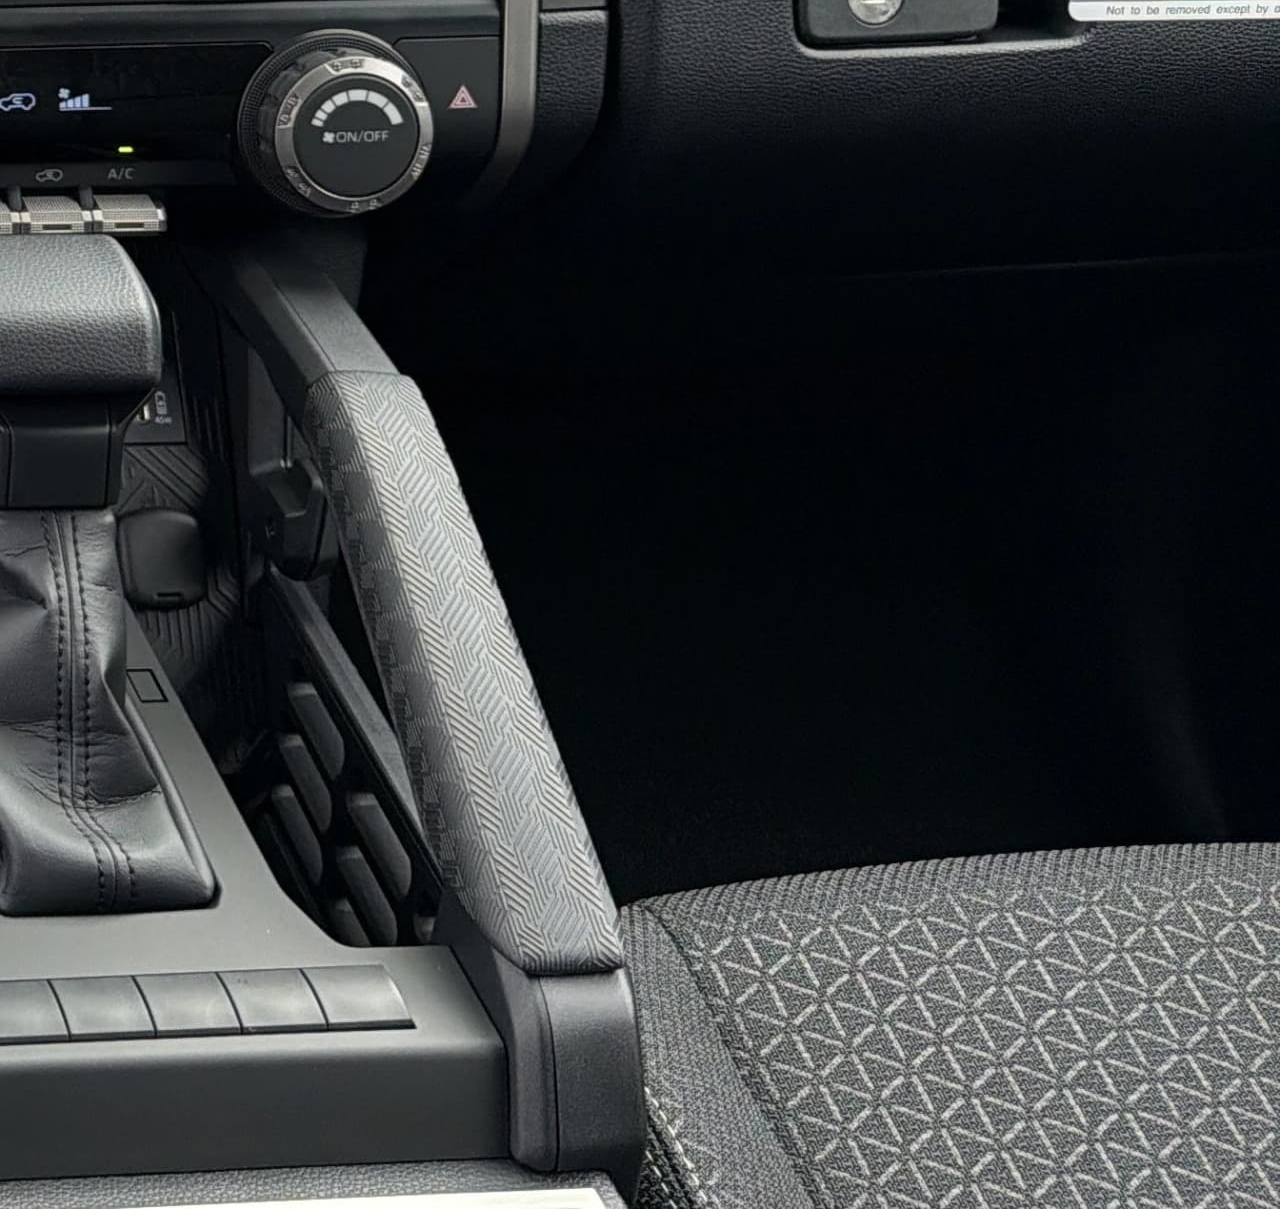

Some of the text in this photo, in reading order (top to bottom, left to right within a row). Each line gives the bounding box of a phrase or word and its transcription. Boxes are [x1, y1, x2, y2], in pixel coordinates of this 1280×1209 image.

[1105, 5, 1125, 15] Not
[1131, 5, 1141, 15] to
[1146, 5, 1159, 15] be
[1165, 4, 1211, 15] removed
[1216, 3, 1250, 16] except
[1256, 3, 1269, 16] by
[336, 130, 389, 144] ON/OFF
[107, 167, 135, 181] A/C
